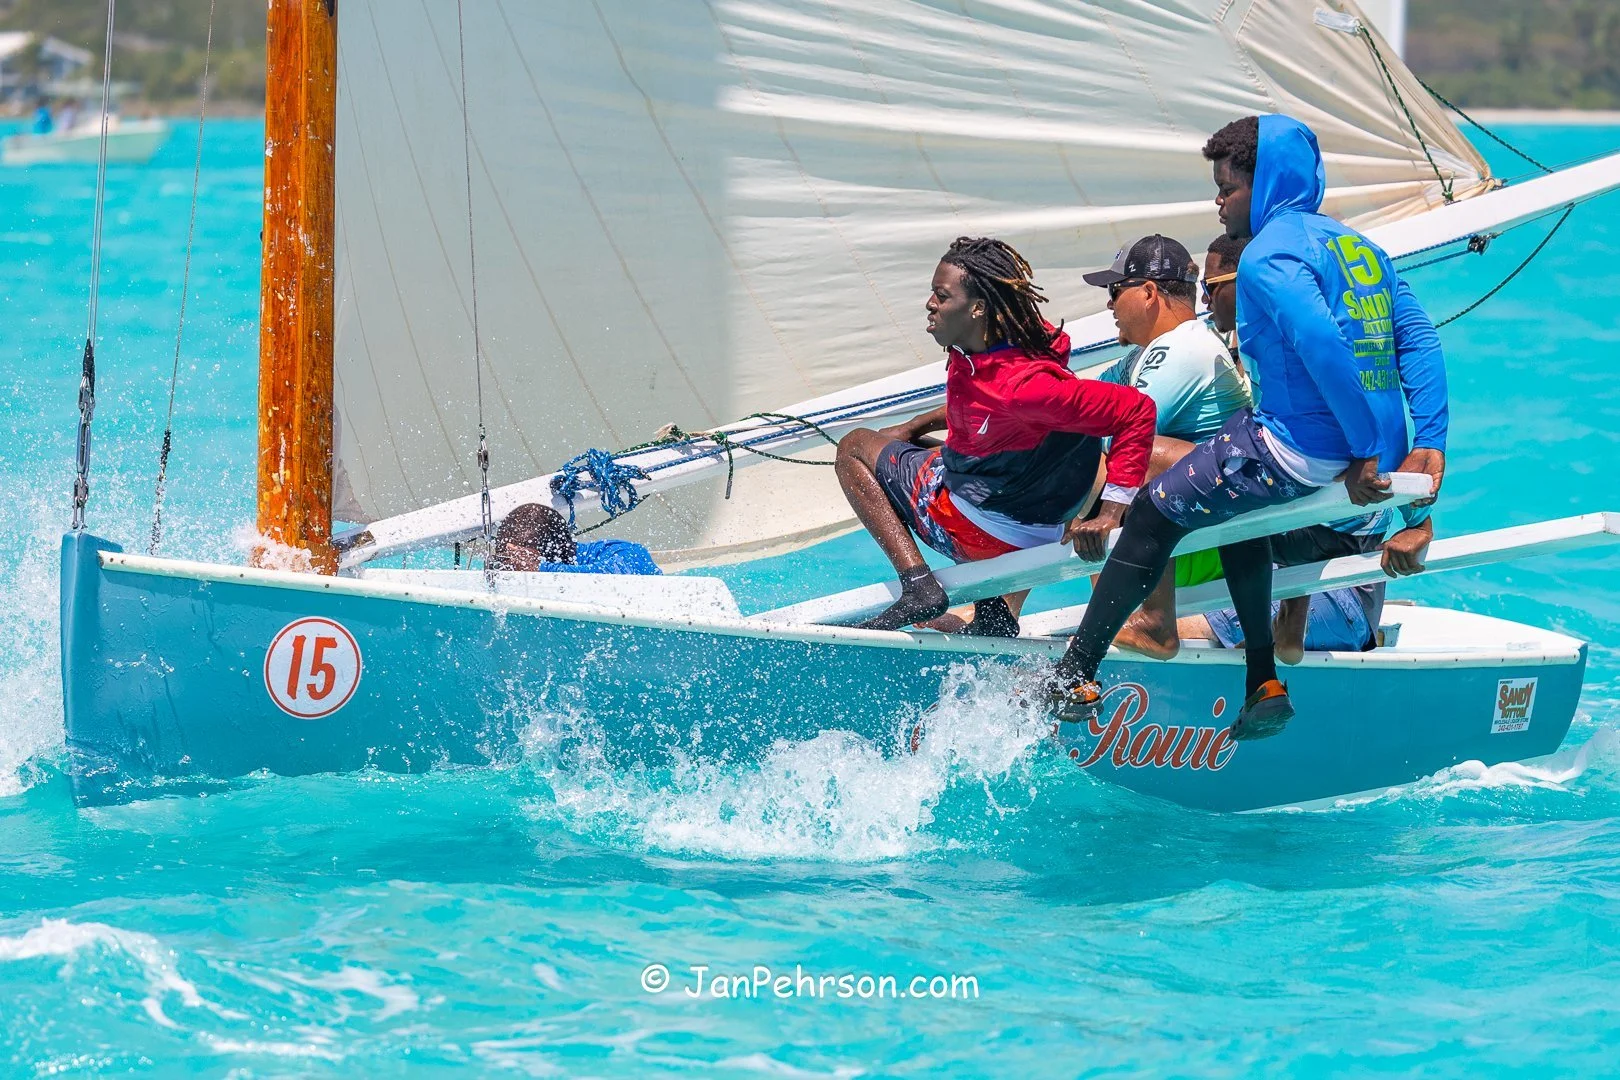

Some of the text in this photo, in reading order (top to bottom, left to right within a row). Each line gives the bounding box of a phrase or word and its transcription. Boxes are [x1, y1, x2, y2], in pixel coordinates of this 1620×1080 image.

[1326, 235, 1383, 288] 15
[1343, 288, 1392, 320] SNDY
[286, 634, 338, 701] 15
[1498, 682, 1535, 710] SANDY
